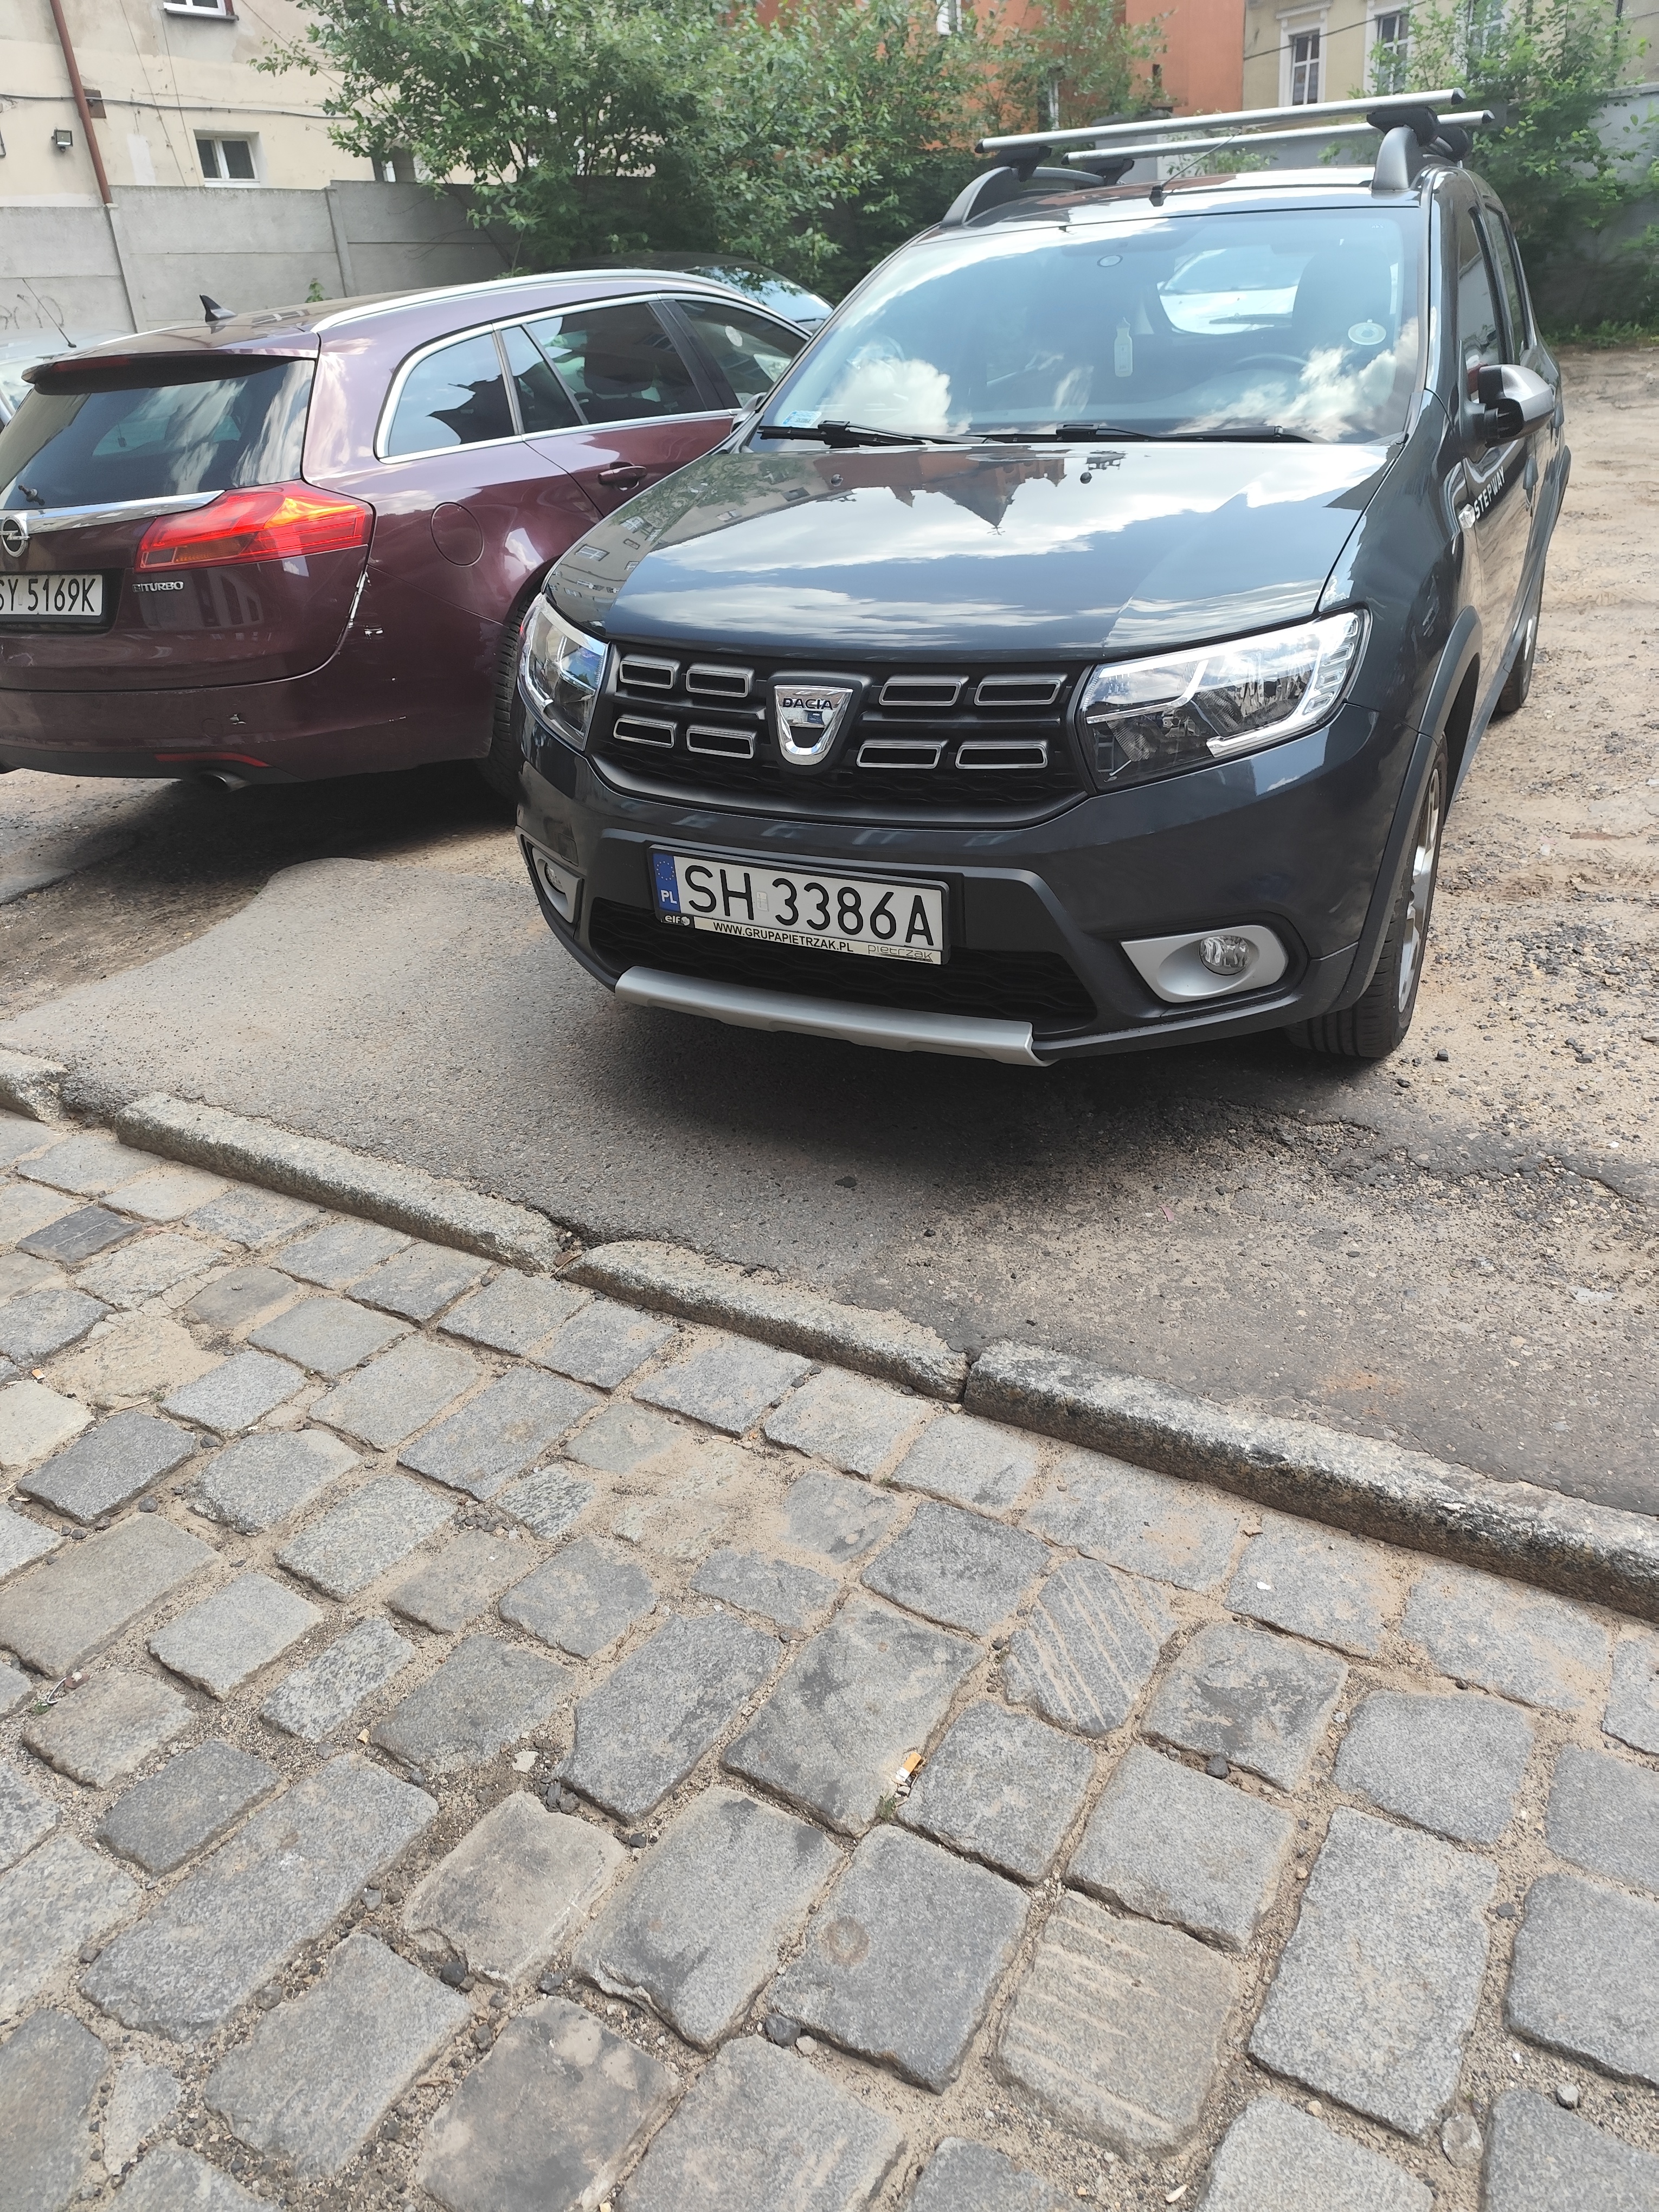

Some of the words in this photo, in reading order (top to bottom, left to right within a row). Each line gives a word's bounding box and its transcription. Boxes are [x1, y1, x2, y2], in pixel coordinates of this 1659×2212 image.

[1474, 466, 1505, 519] STEPWAY
[28, 578, 96, 612] 5169K
[782, 697, 833, 710] DACIA
[660, 890, 677, 904] PL
[685, 865, 755, 920] SH
[772, 878, 934, 946] 3386A
[713, 922, 853, 952] WWW.GRUPAPIETRZAK.PL
[867, 944, 933, 962] pietrzak
